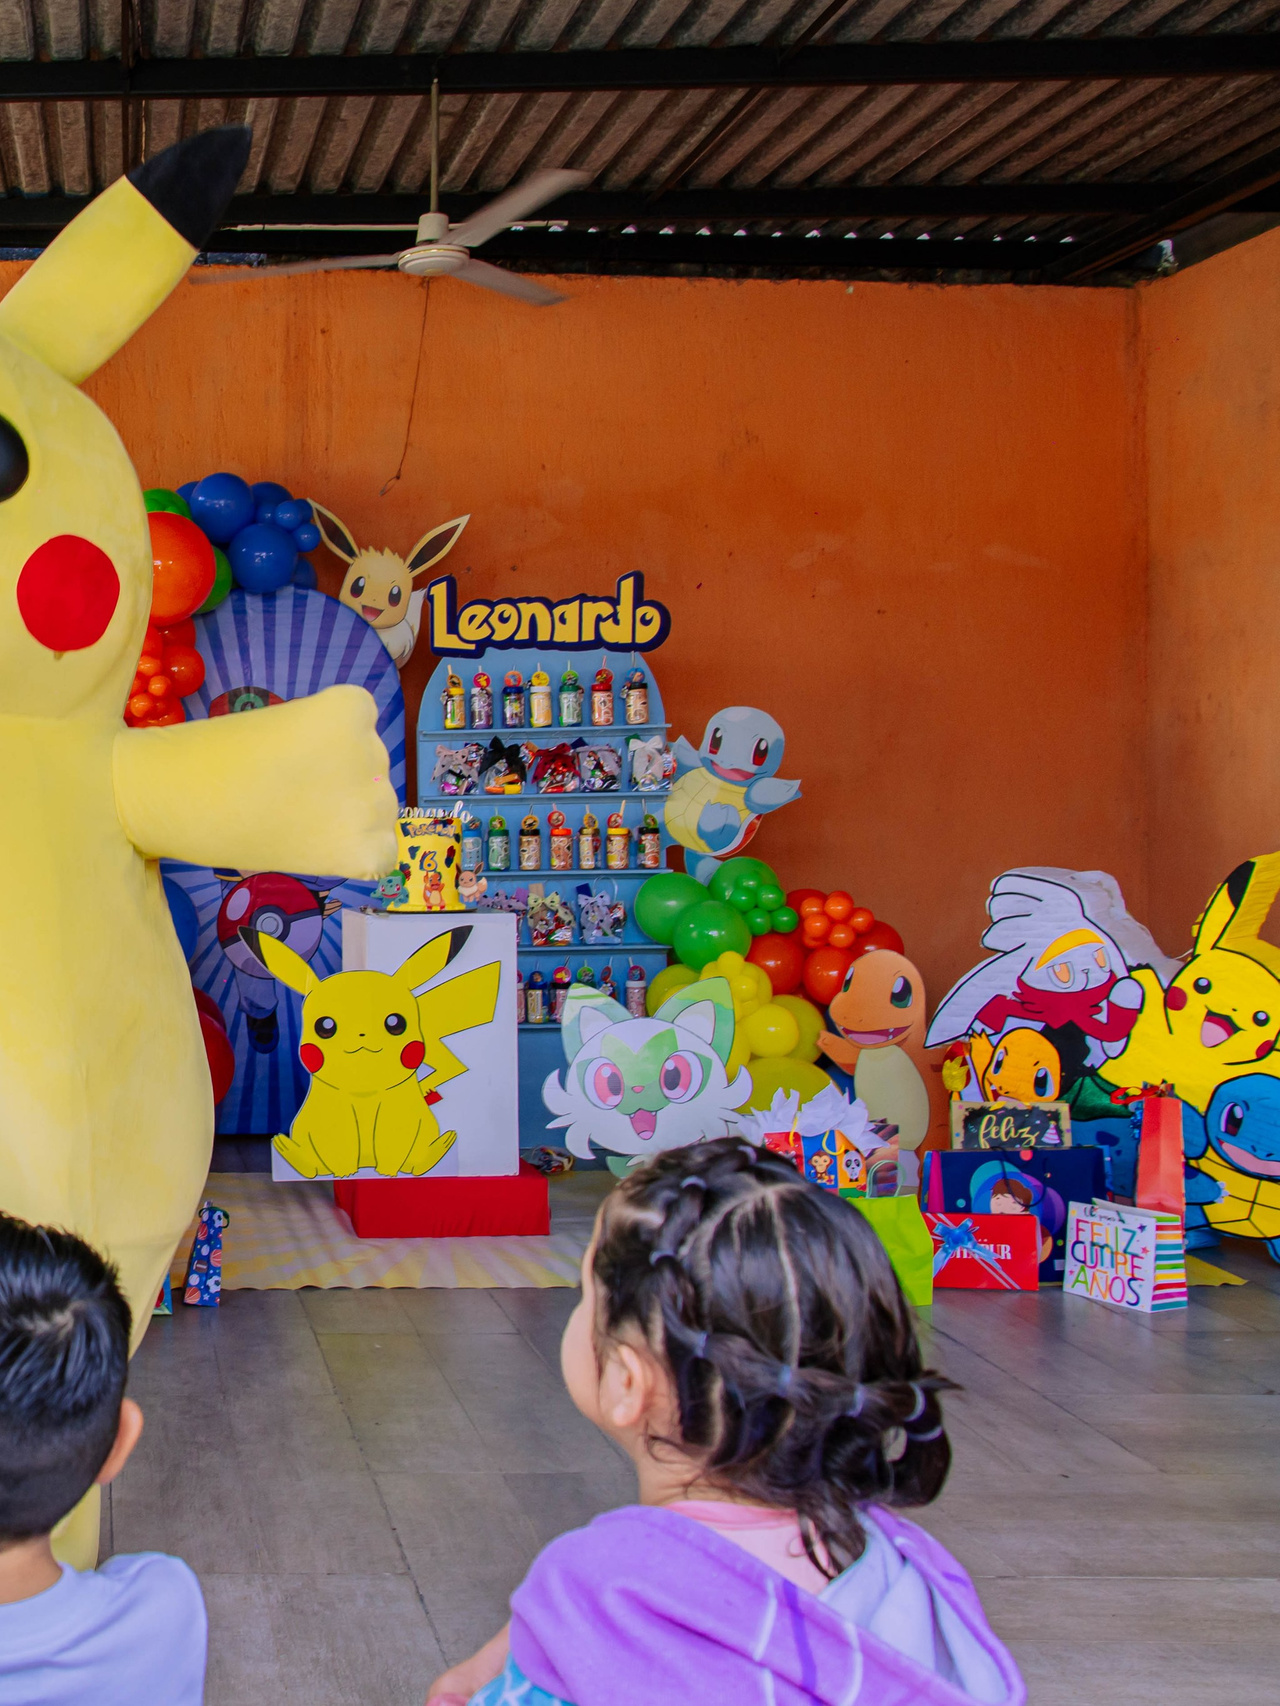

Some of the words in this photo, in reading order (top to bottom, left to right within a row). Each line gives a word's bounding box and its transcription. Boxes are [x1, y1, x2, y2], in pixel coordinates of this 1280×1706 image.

[428, 574, 664, 652] Leonardo
[397, 800, 473, 823] eonardo
[422, 851, 437, 872] 6
[1075, 1218, 1140, 1257] FELIZ
[1070, 1264, 1141, 1306] AÑOS
